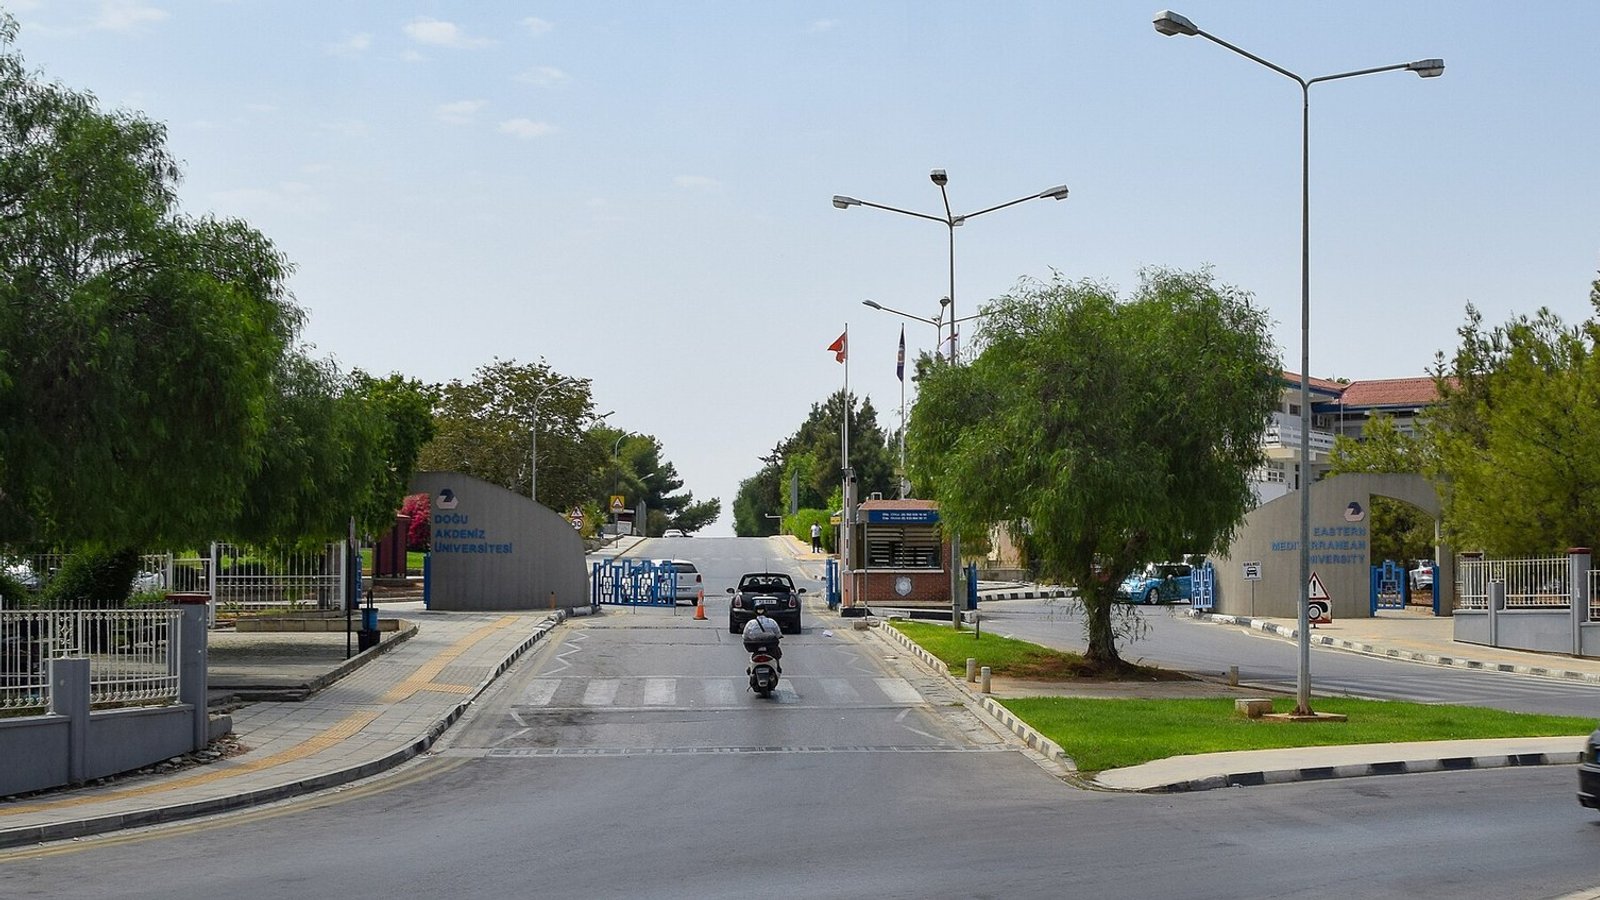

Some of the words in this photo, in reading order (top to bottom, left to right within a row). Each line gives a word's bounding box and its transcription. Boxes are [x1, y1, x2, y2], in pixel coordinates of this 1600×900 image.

[434, 513, 468, 524] DOĞU
[434, 528, 486, 539] AKDENİZ
[1313, 527, 1367, 536] EASTERN
[1271, 541, 1367, 551] MEDIRRANEAN
